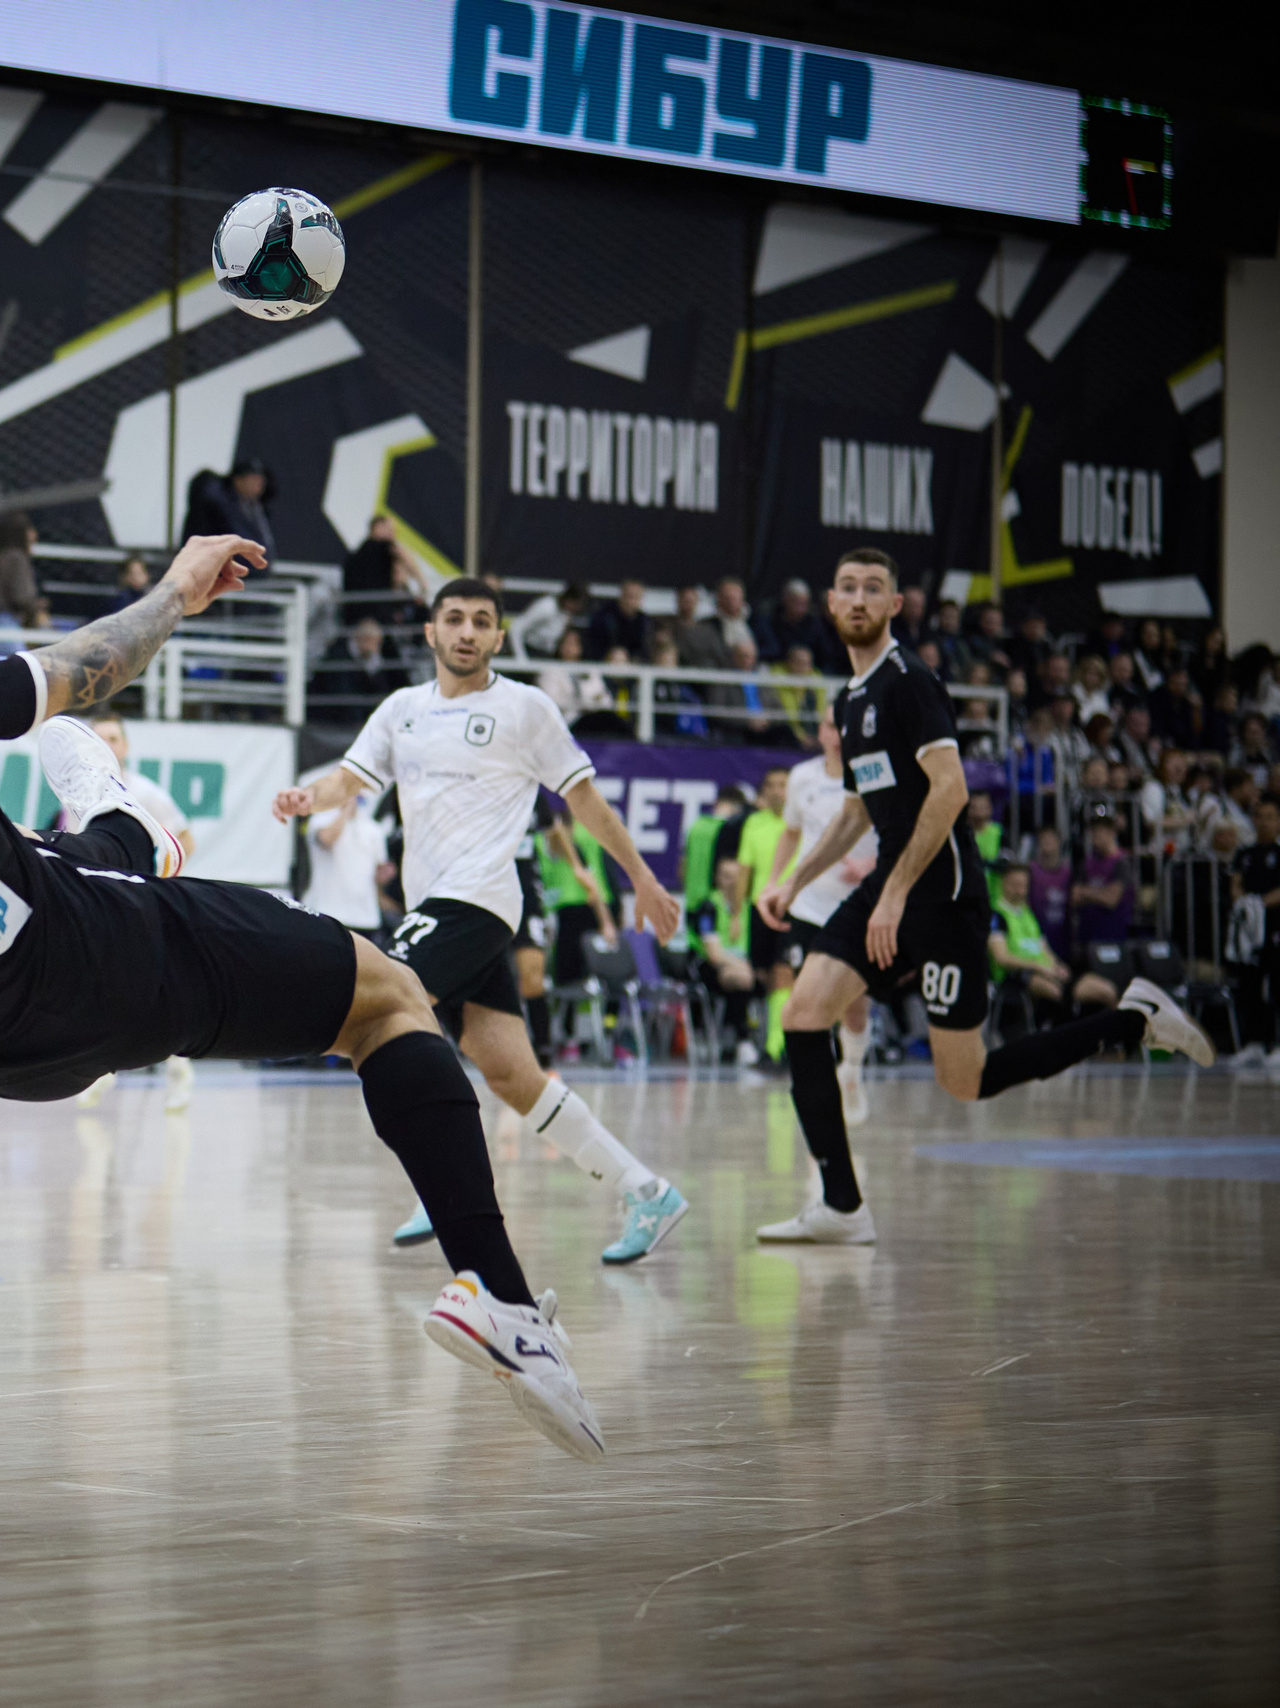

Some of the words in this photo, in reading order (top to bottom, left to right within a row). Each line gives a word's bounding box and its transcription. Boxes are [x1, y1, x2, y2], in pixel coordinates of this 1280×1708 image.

[448, 0, 874, 175] СИБУР
[507, 401, 718, 513] ТЕРРИТОРИЯ
[821, 438, 934, 534] НАШИХ
[1061, 461, 1163, 558] ПОБЕД!
[393, 912, 438, 945] 77
[922, 961, 961, 1006] 80
